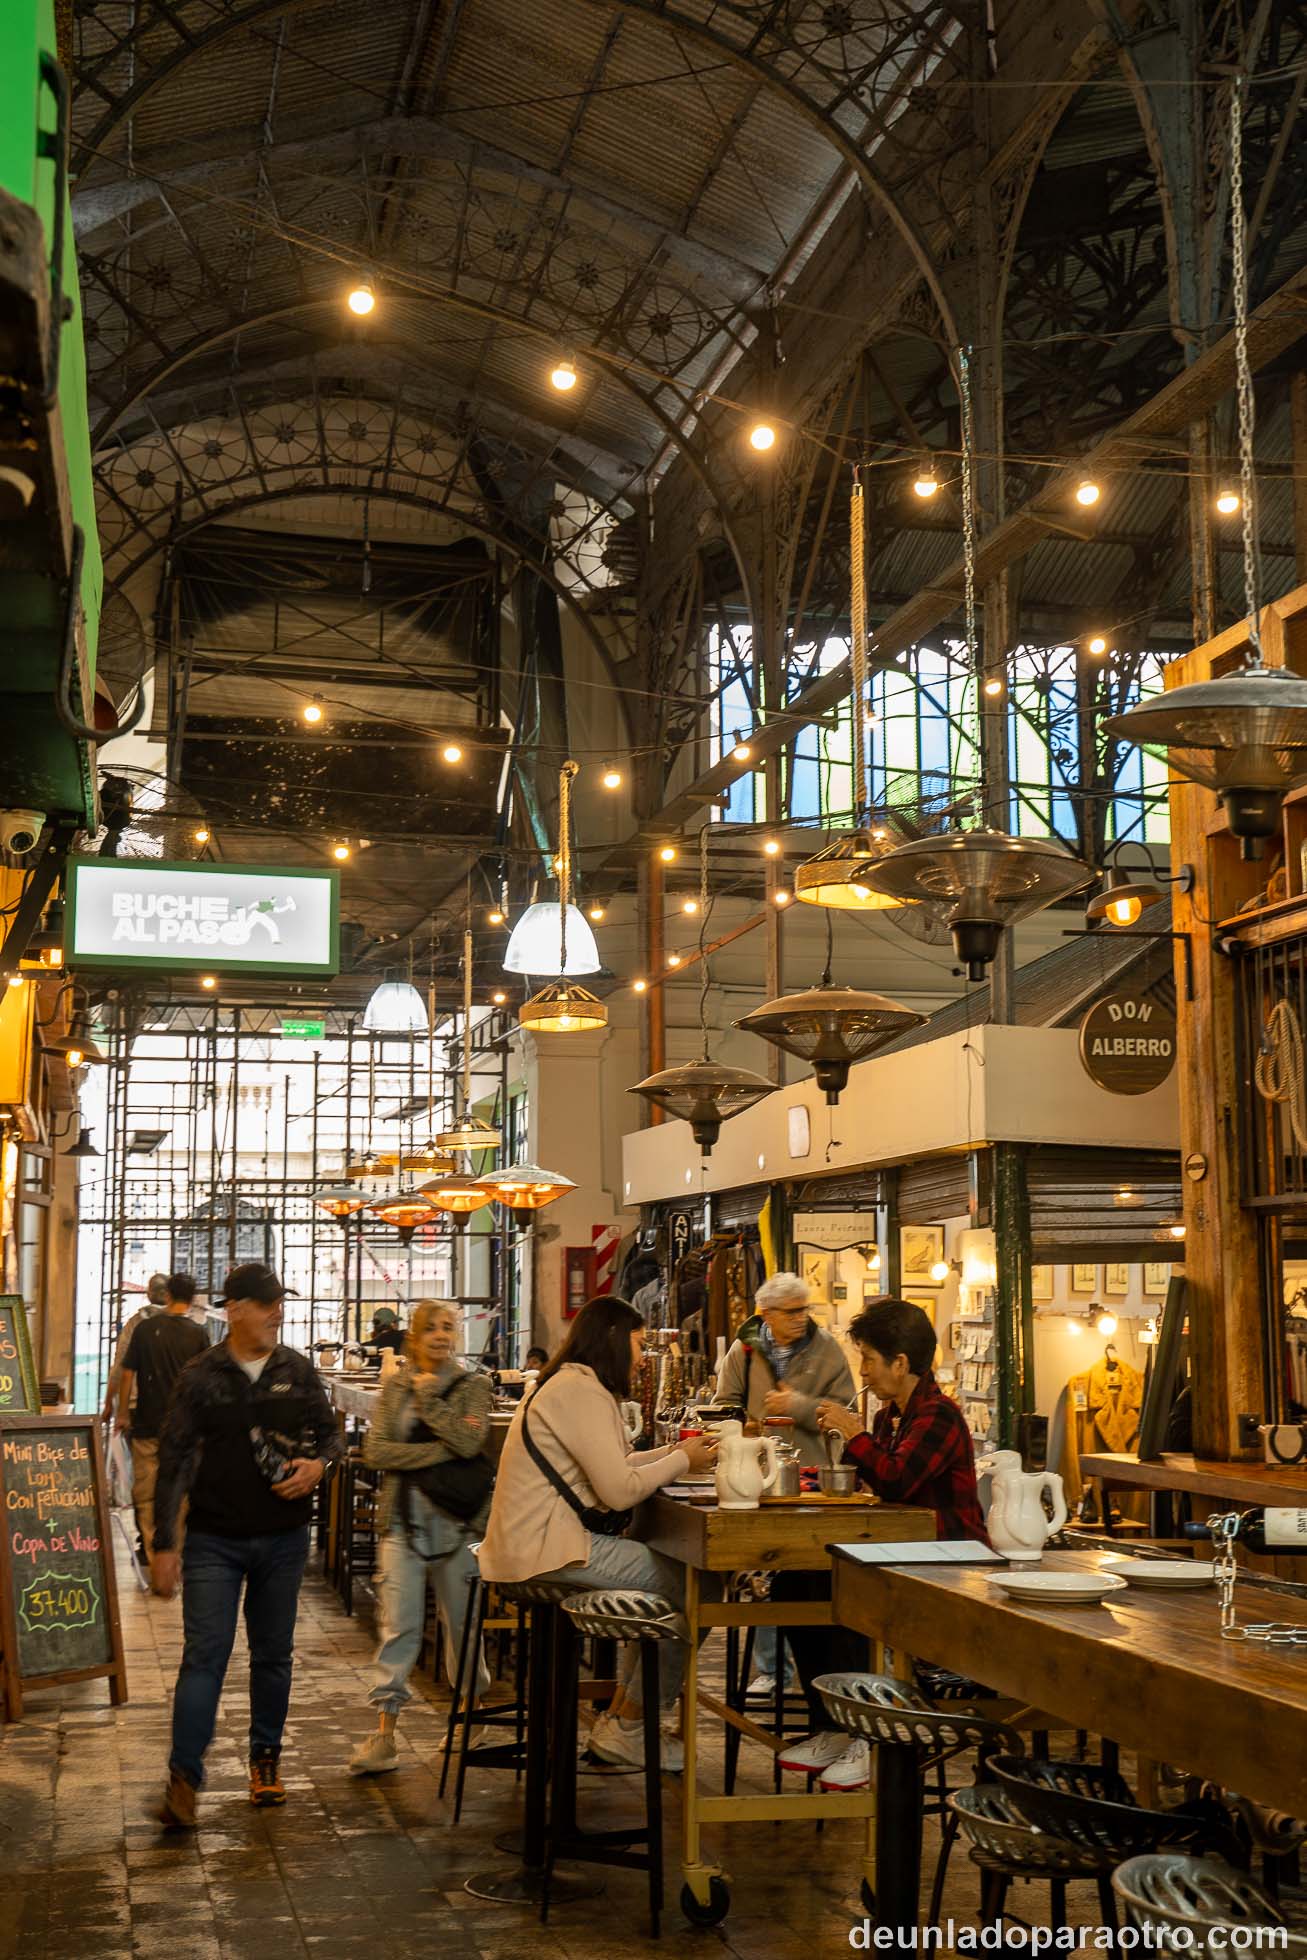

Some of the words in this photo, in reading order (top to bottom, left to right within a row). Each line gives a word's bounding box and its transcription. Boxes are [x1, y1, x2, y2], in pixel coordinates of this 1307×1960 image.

[112, 893, 230, 921] BUCHE
[111, 917, 156, 943] AL
[158, 919, 251, 946] PASO
[1107, 1001, 1153, 1022] DON
[1091, 1038, 1172, 1057] ALBERRO
[674, 1215, 688, 1266] ANTI
[29, 1589, 89, 1617] 37.400
